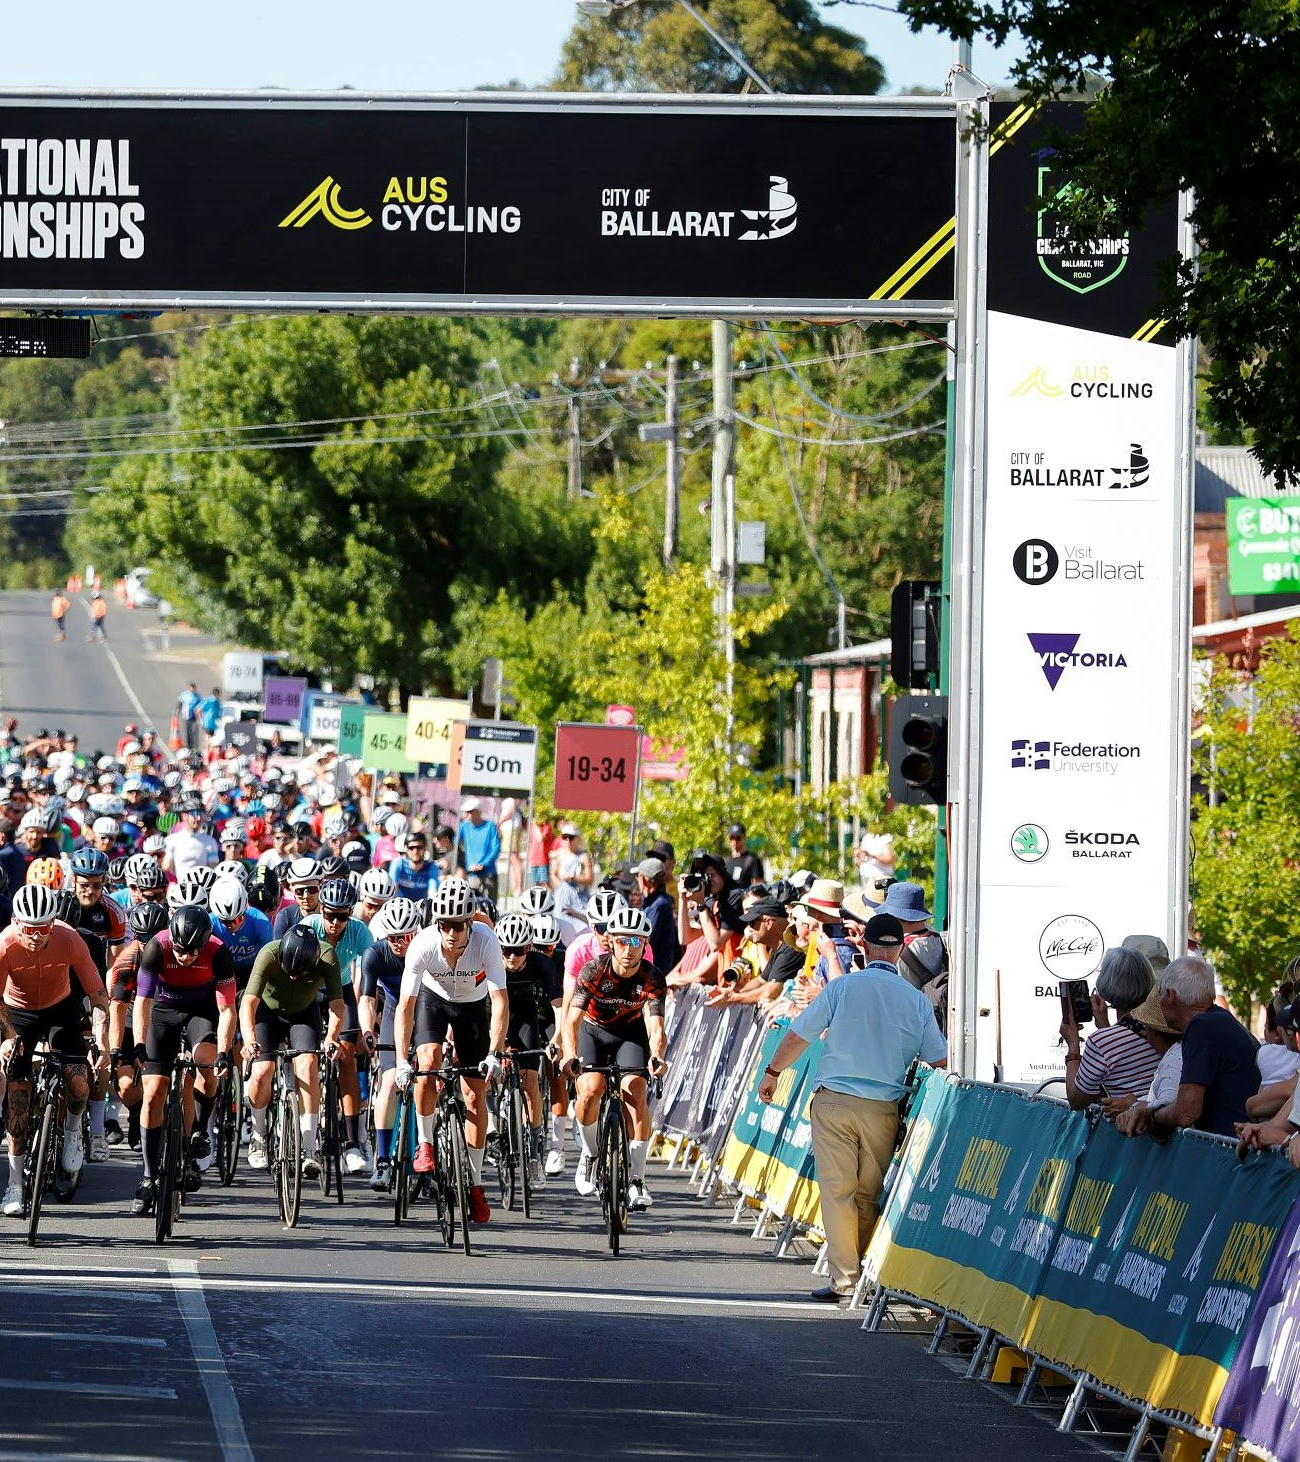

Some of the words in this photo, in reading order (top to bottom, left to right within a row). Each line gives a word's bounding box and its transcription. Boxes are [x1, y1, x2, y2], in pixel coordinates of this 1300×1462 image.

[383, 176, 448, 203] AUS
[602, 188, 630, 207] CITY
[635, 189, 650, 207] OF
[381, 205, 521, 233] CYCLING
[601, 211, 735, 237] BALLARAT
[1062, 260, 1092, 268] BALLARAT,
[1094, 260, 1104, 268] VIC
[1072, 366, 1109, 381] AUS
[1070, 382, 1153, 398] CYCLING
[1011, 452, 1030, 465] CITY
[1035, 453, 1044, 465] OF
[1011, 468, 1104, 486] BALLARAT
[1064, 546, 1092, 559] Visit
[1065, 560, 1144, 580] Ballarat
[1036, 652, 1127, 667] VICTORIA
[1053, 742, 1140, 758] Federation
[473, 754, 522, 775] 50m
[568, 755, 626, 783] 19-34
[1053, 759, 1118, 775] University
[1064, 830, 1140, 845] ŠKODA
[1072, 850, 1132, 858] BALLARAT
[1046, 937, 1098, 957] McCafé
